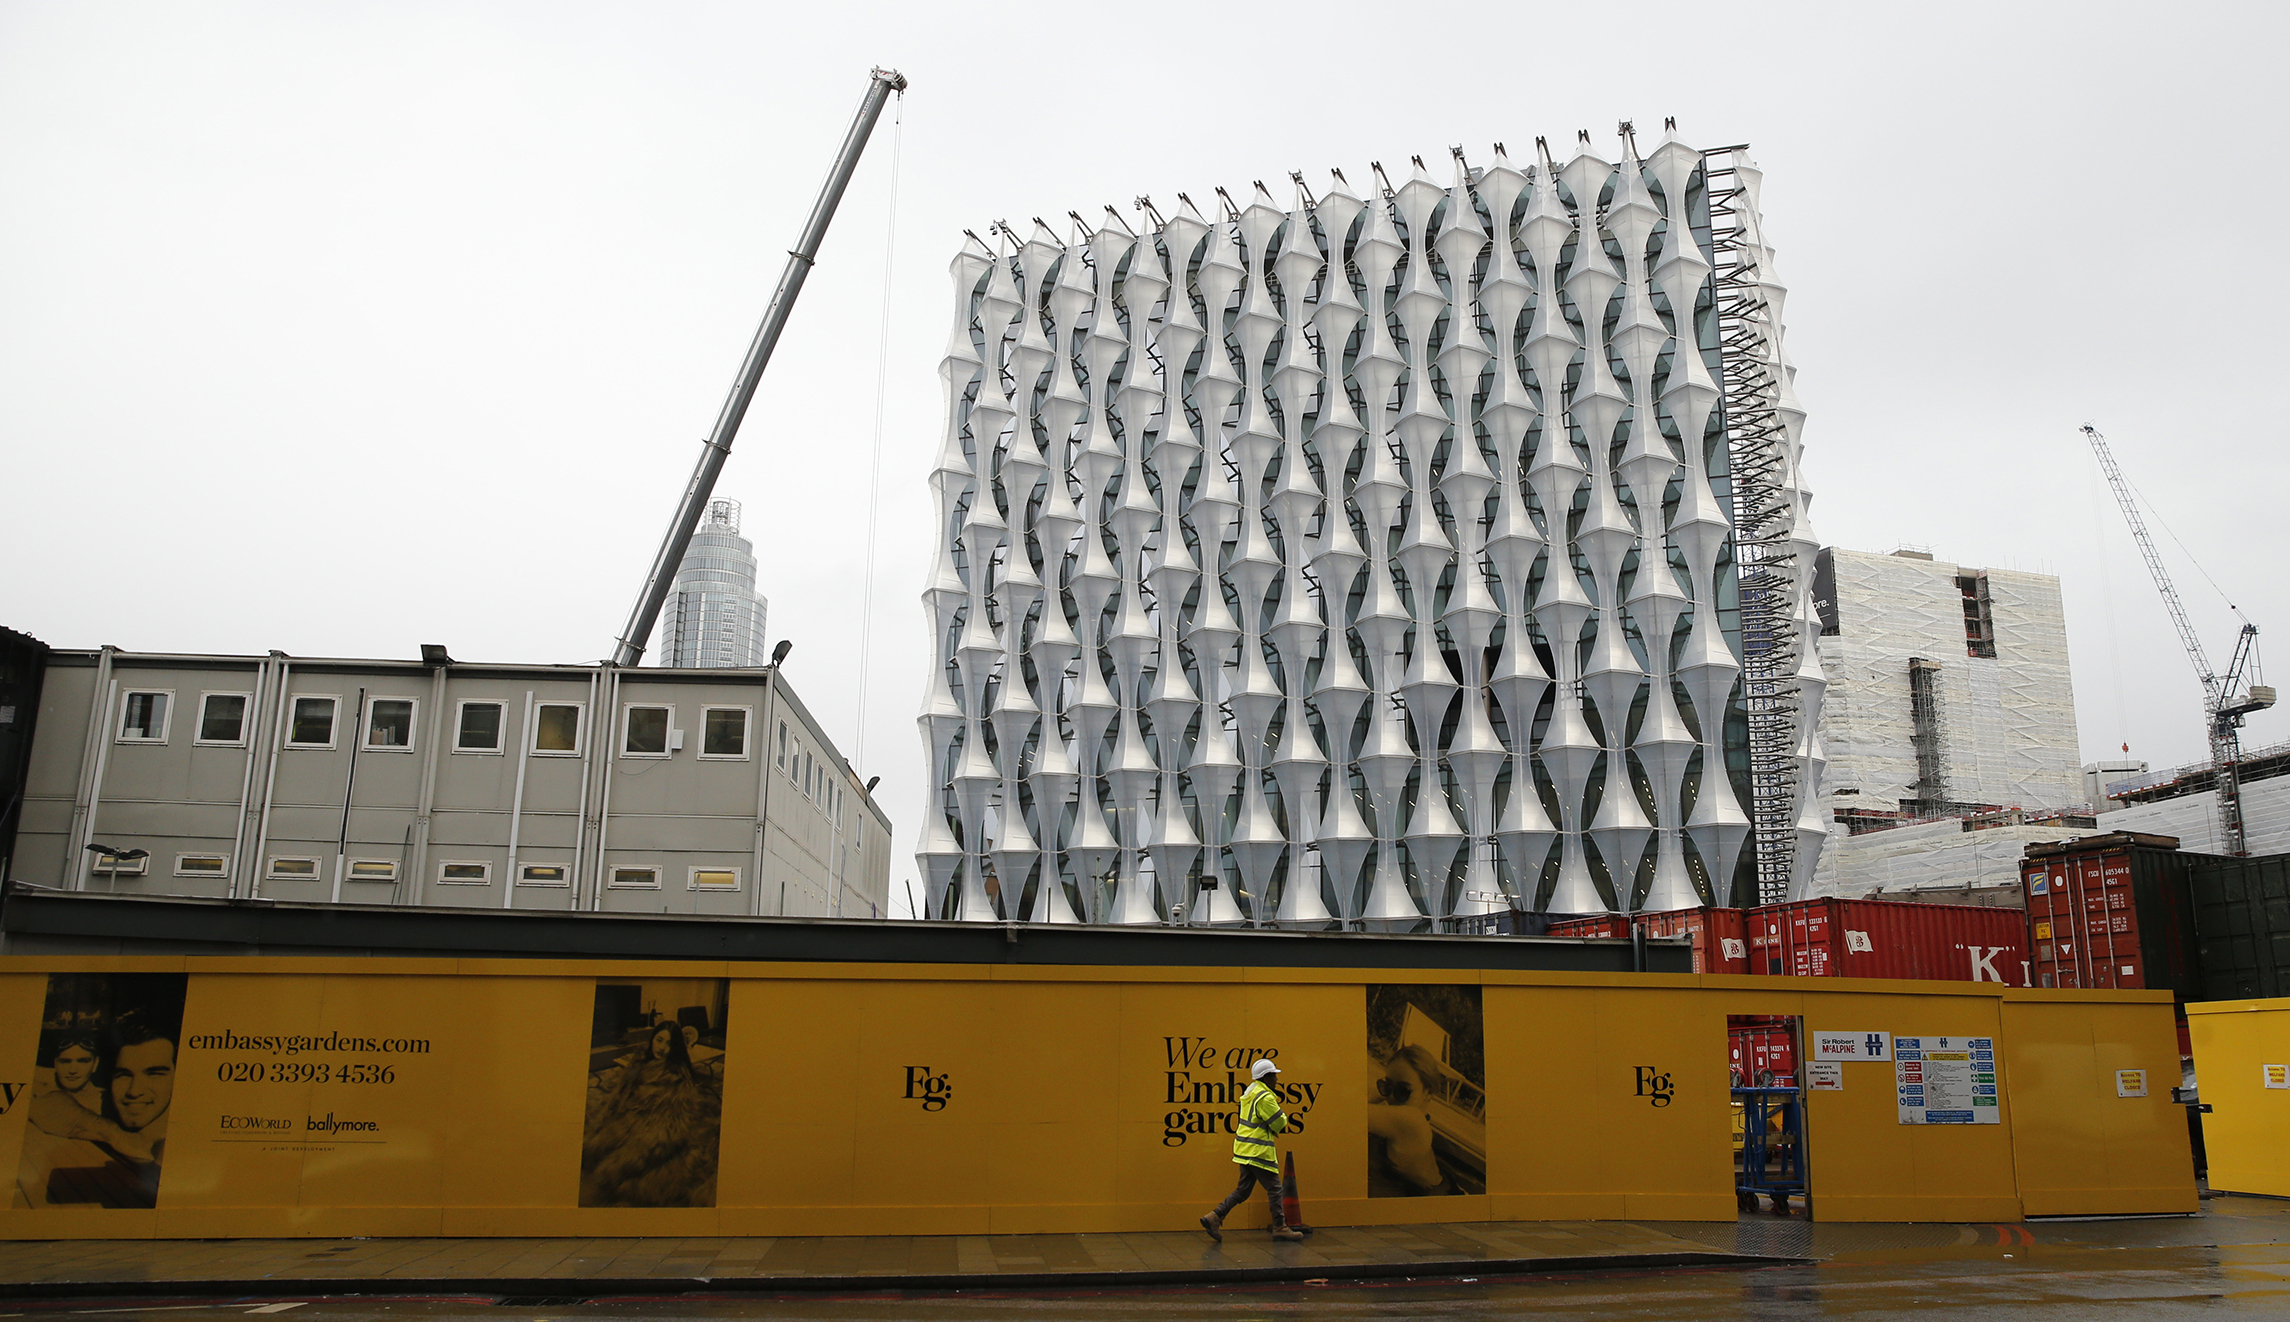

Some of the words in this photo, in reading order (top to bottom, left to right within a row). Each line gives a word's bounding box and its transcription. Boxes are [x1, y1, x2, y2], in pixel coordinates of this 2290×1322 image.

[188, 1028, 431, 1055] embassygardens.com
[1163, 1036, 1216, 1069] We
[217, 1062, 265, 1082] 020
[270, 1063, 330, 1084] 3393
[336, 1064, 396, 1085] 4536
[1163, 1071, 1324, 1113] Embssy
[307, 1112, 380, 1135] ballymore.
[1162, 1104, 1305, 1147] gards
